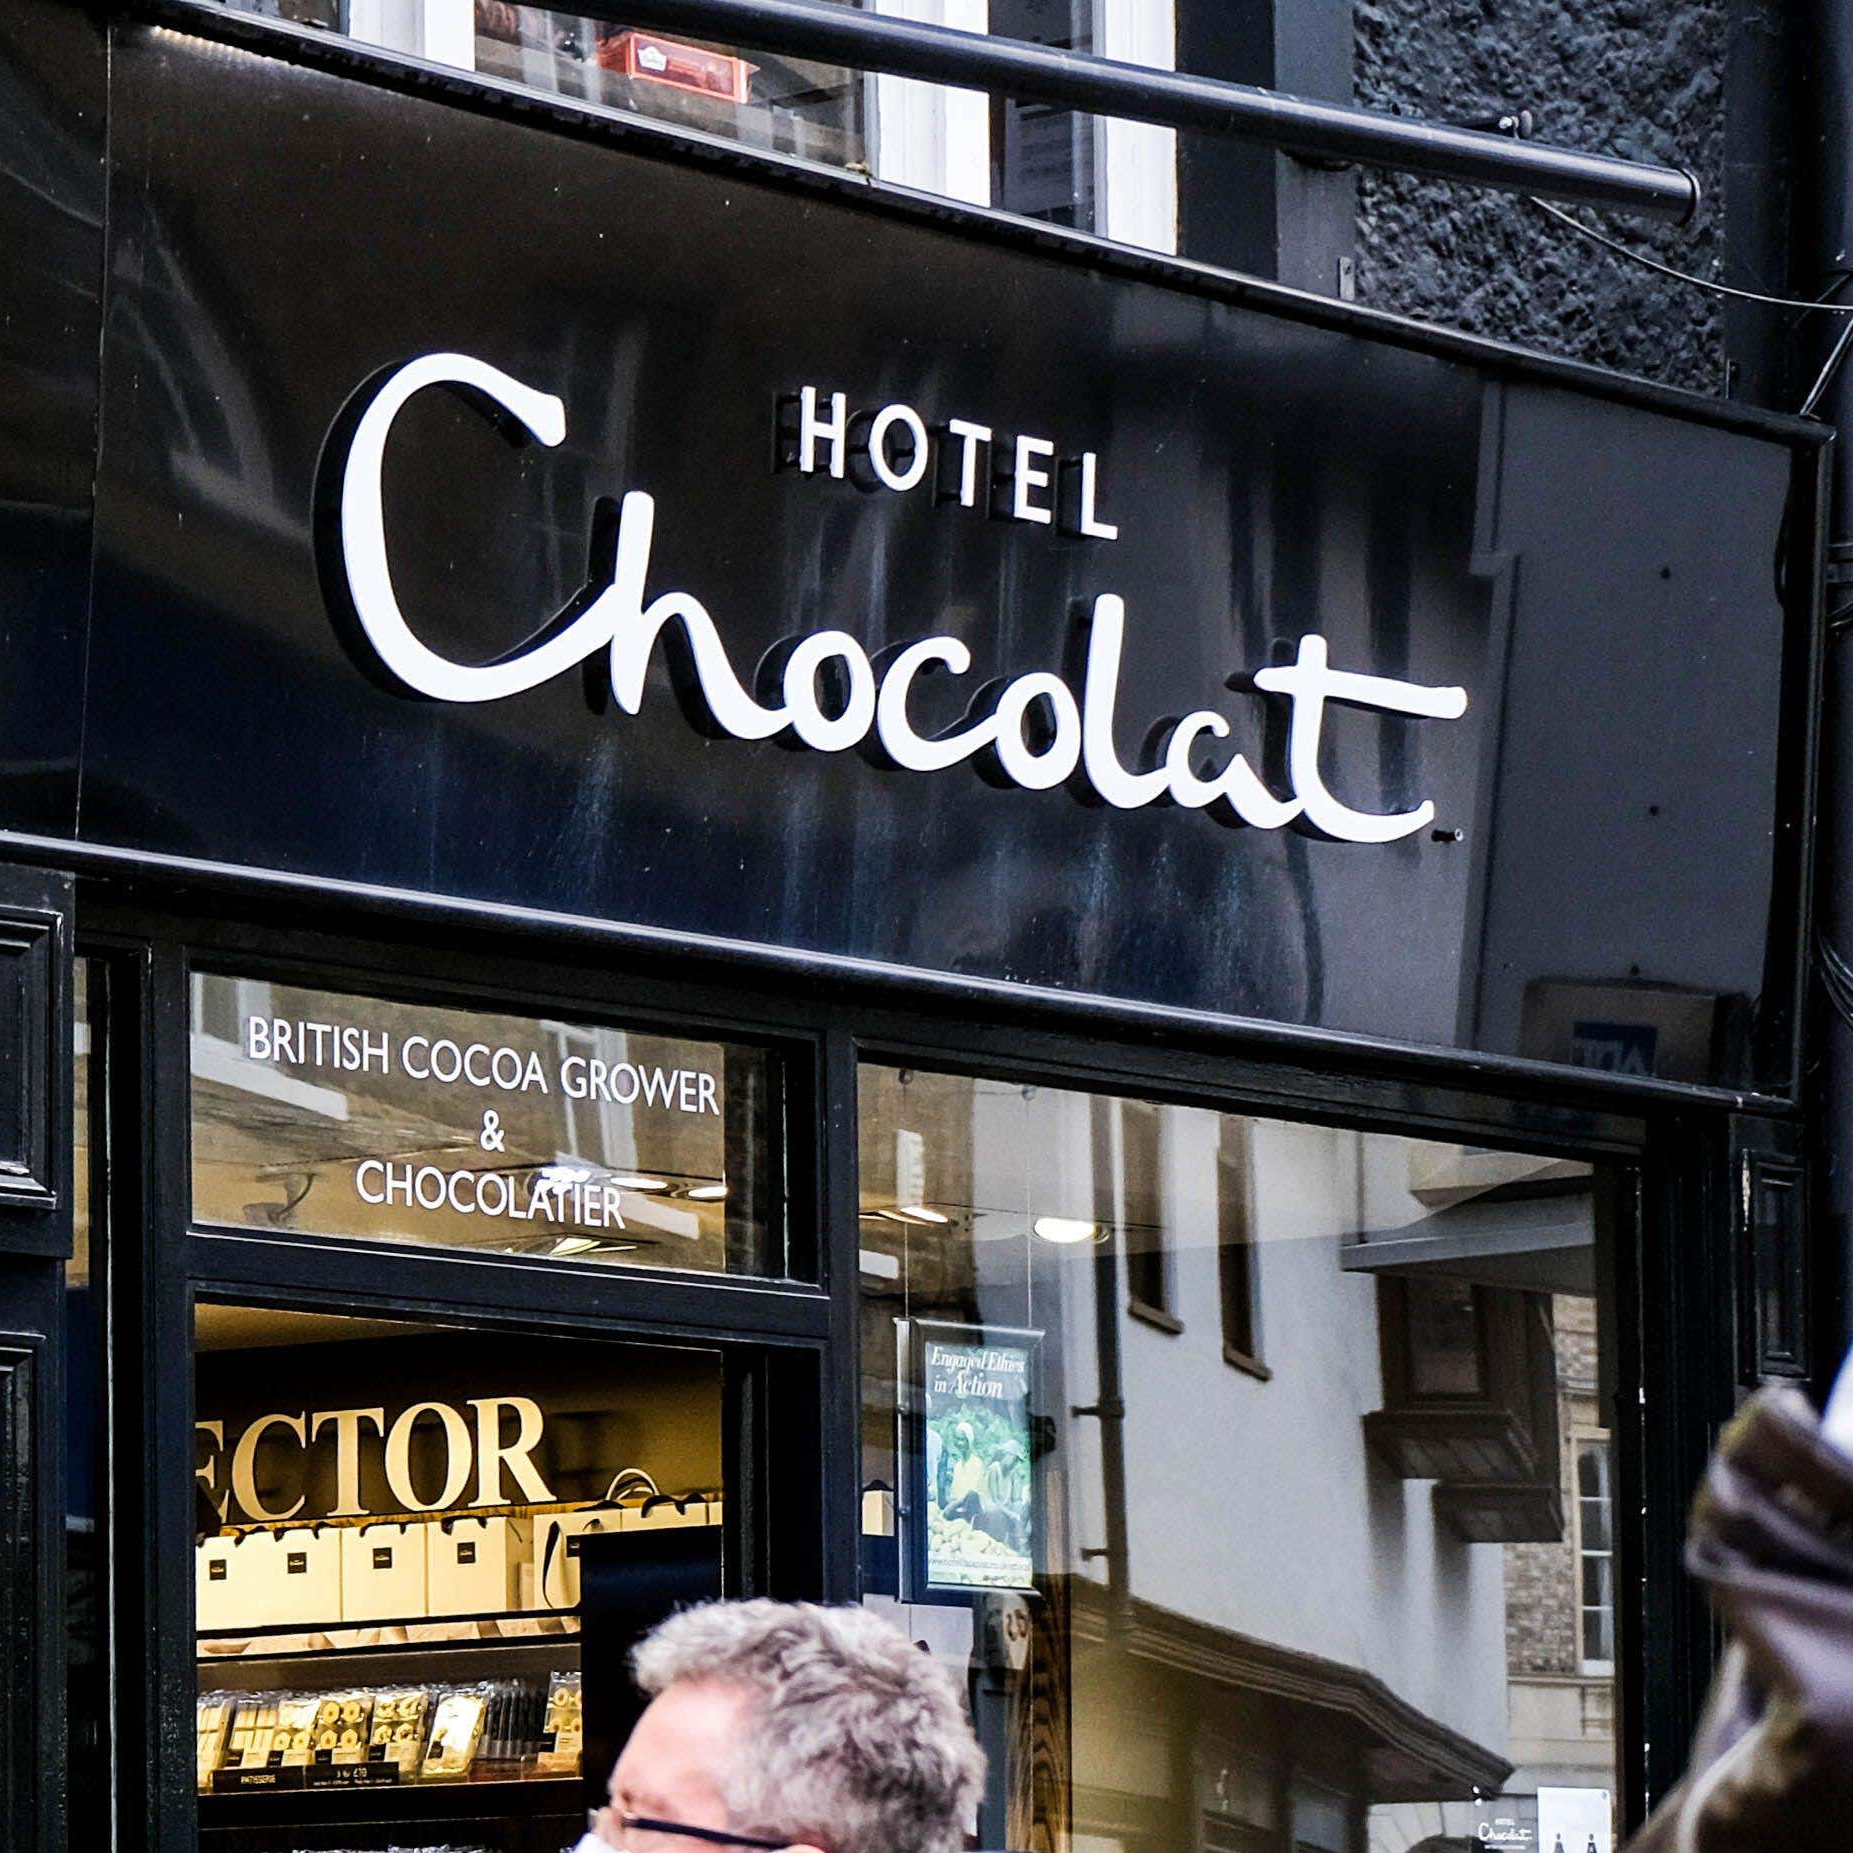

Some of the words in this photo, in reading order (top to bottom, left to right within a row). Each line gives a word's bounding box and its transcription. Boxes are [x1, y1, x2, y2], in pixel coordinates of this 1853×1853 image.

[798, 385, 1119, 540] HOTEL
[341, 351, 1468, 844] Chocolat
[248, 1015, 390, 1075] BRITISH
[402, 1036, 548, 1093] COCOA
[561, 1056, 720, 1115] GROWER
[479, 1109, 506, 1153] &
[356, 1160, 627, 1229] CHOCOLATIER
[949, 1369, 1003, 1398] Action
